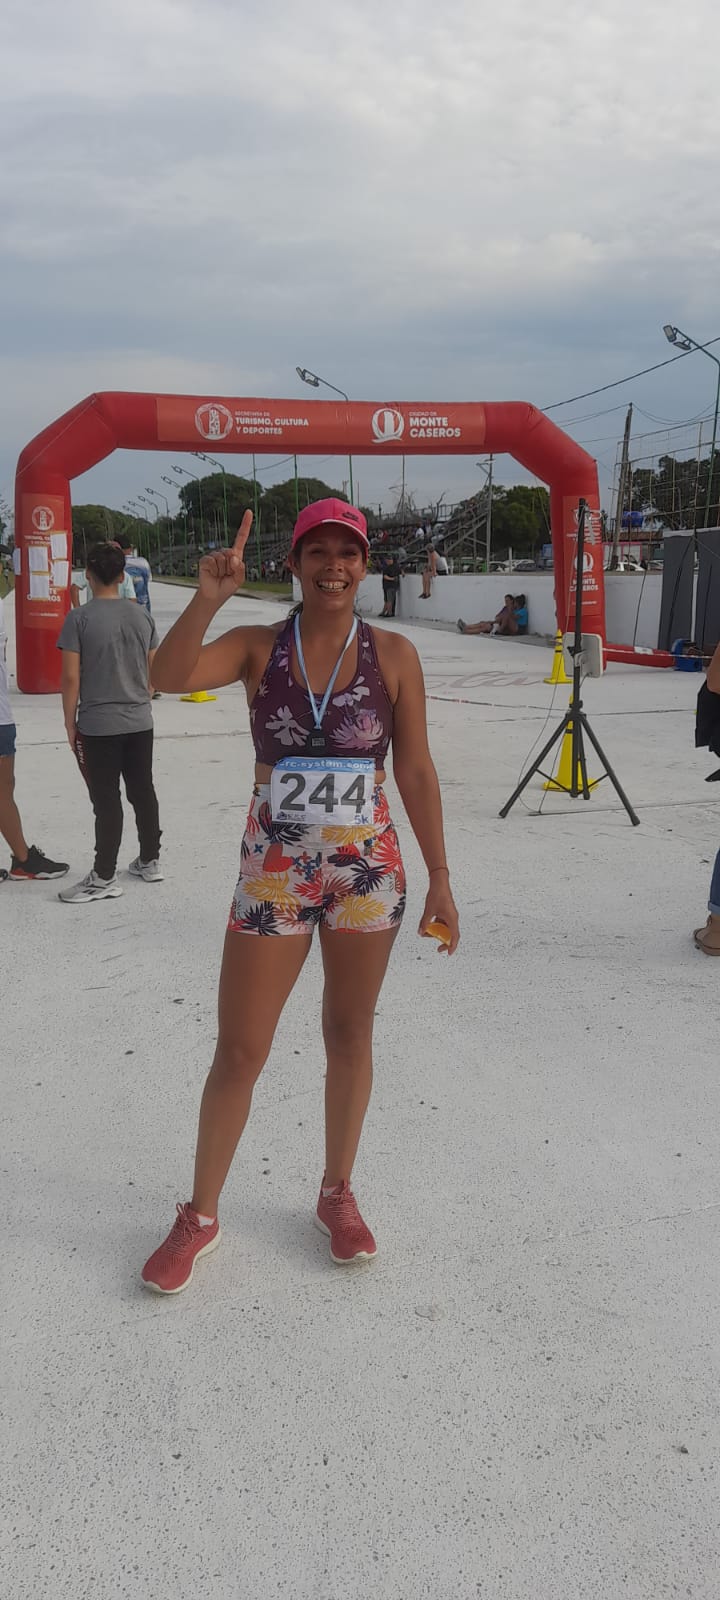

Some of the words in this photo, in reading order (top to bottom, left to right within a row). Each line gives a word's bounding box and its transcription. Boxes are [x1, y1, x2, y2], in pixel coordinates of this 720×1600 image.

[235, 417, 273, 426] TURISMO,
[274, 418, 309, 426] CULTURA
[410, 417, 448, 427] MONTE
[242, 427, 282, 435] DEPORTES
[410, 427, 461, 438] CASEROS
[279, 773, 366, 813] 244
